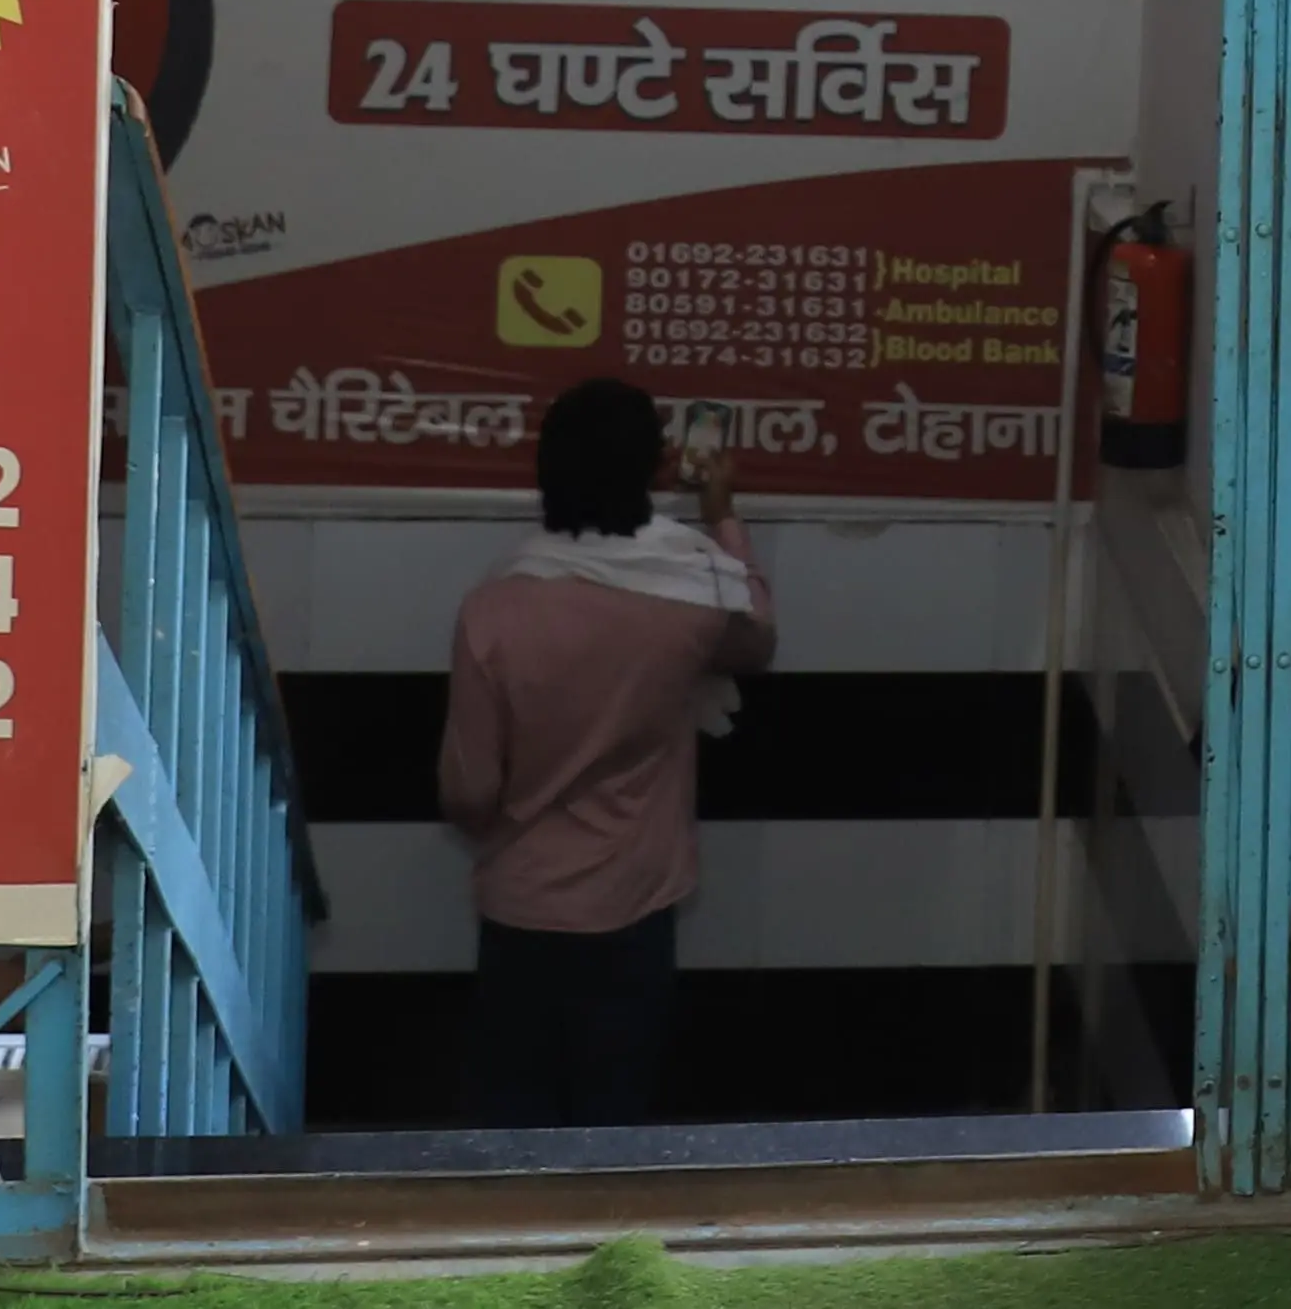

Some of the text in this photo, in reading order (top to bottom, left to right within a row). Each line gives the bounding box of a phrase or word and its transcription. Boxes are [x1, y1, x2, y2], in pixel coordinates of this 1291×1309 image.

[359, 17, 980, 126] 24 घण्टे सर्विस
[626, 241, 867, 267] 01692-231631
[626, 267, 867, 293] 90172-31631
[624, 293, 866, 319] 80591-31631
[623, 319, 868, 344] 01692-231632
[624, 344, 866, 369] 70274-31632
[983, 337, 1060, 364] Bank
[269, 366, 533, 447] चैरिटेबल
[863, 381, 1061, 460] टोहाना
